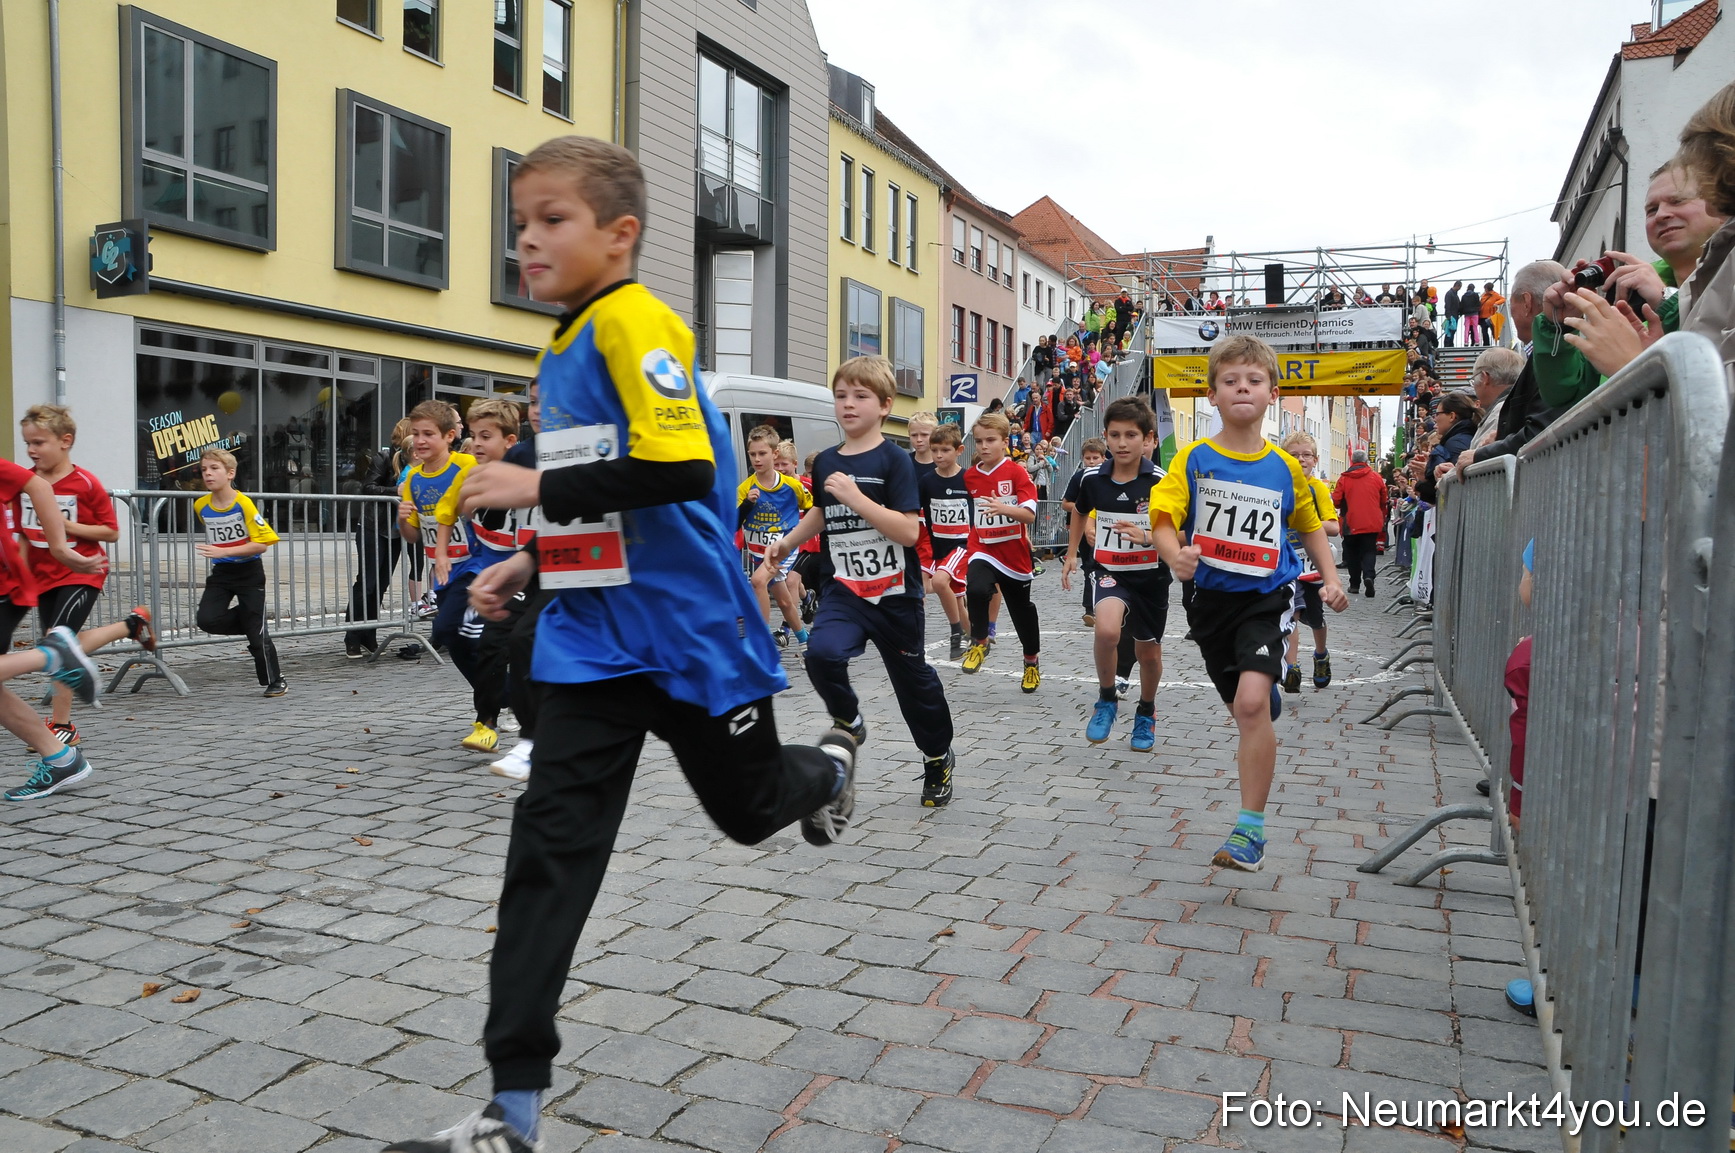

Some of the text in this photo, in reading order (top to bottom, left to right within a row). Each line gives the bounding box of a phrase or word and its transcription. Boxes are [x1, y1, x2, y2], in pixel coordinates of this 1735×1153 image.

[1255, 317, 1354, 330] EfficientDynamics
[1254, 330, 1293, 339] Verbrauch.
[1314, 328, 1355, 337] ahrfreude.
[149, 410, 183, 433] SEASON
[151, 414, 220, 460] OPENING
[186, 447, 201, 463] FALL
[1198, 486, 1271, 507] PARTL Neumarkt
[933, 508, 966, 524] 7524
[1097, 515, 1114, 525] PARTL
[1205, 501, 1275, 544] 7142
[209, 523, 246, 542] 7528
[985, 529, 1008, 537] Fabian
[830, 536, 888, 550] PARTL Neumarkt
[1111, 554, 1139, 563] Moritz
[1214, 543, 1257, 563] Marius
[837, 545, 898, 578] 7534
